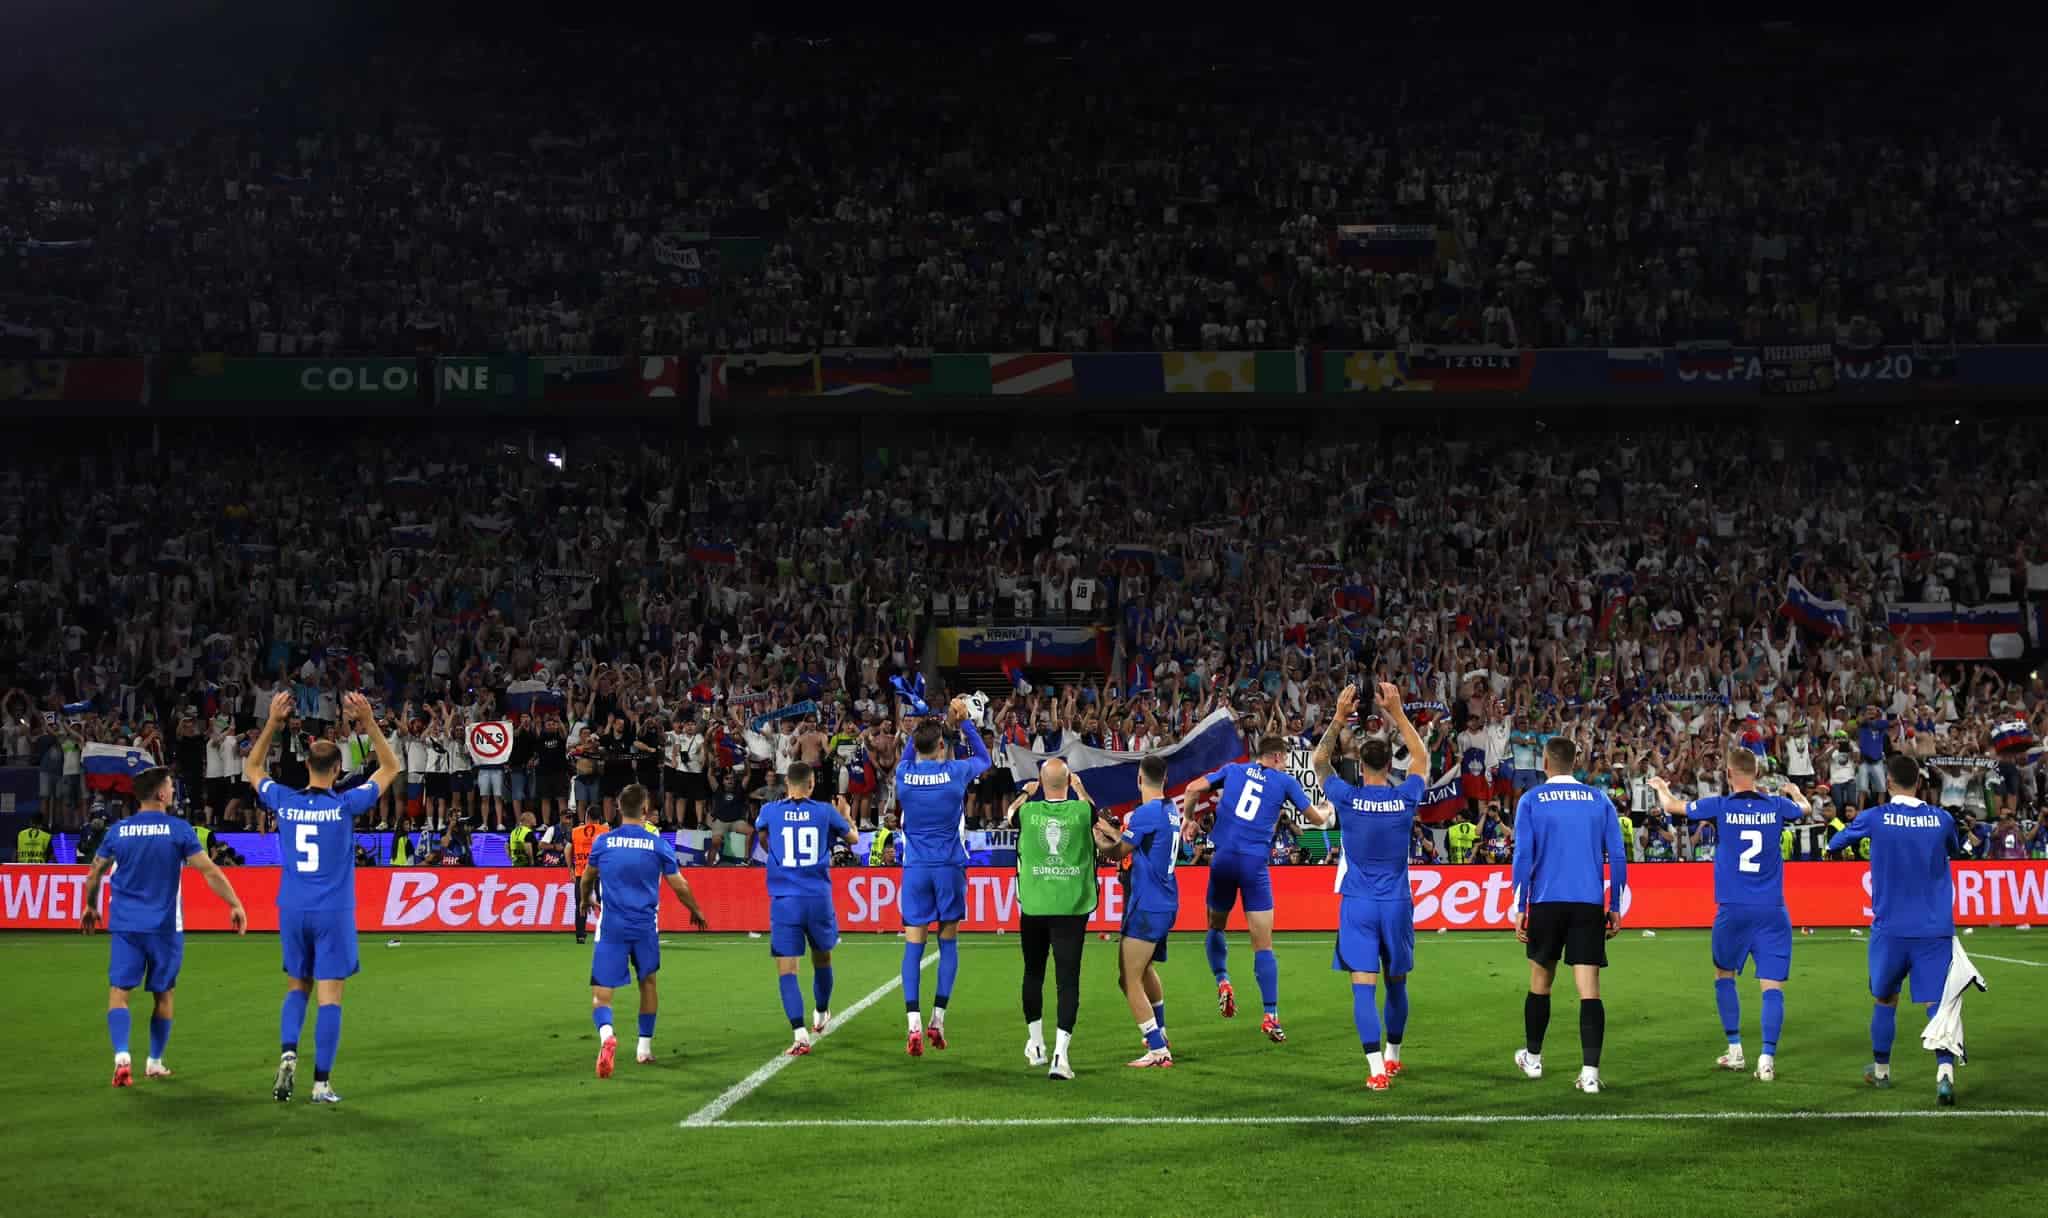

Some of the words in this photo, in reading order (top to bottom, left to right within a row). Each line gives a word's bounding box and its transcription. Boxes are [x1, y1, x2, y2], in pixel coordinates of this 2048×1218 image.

[301, 367, 489, 391] COLONE
[987, 629, 1023, 641] KRAN
[904, 772, 952, 785] SLOVENIJA
[1235, 779, 1264, 821] 6
[1538, 790, 1594, 802] SLOVENIJA
[1353, 798, 1405, 812] SLOVENIJA
[287, 806, 342, 821] STANKOVIĆ
[1884, 813, 1941, 827] SLOVENIJA
[119, 825, 170, 837] SLOVENIJA
[296, 824, 319, 872] 5
[607, 837, 654, 850] SLOVENIJA
[781, 827, 819, 867] 19
[1739, 830, 1763, 872] 2
